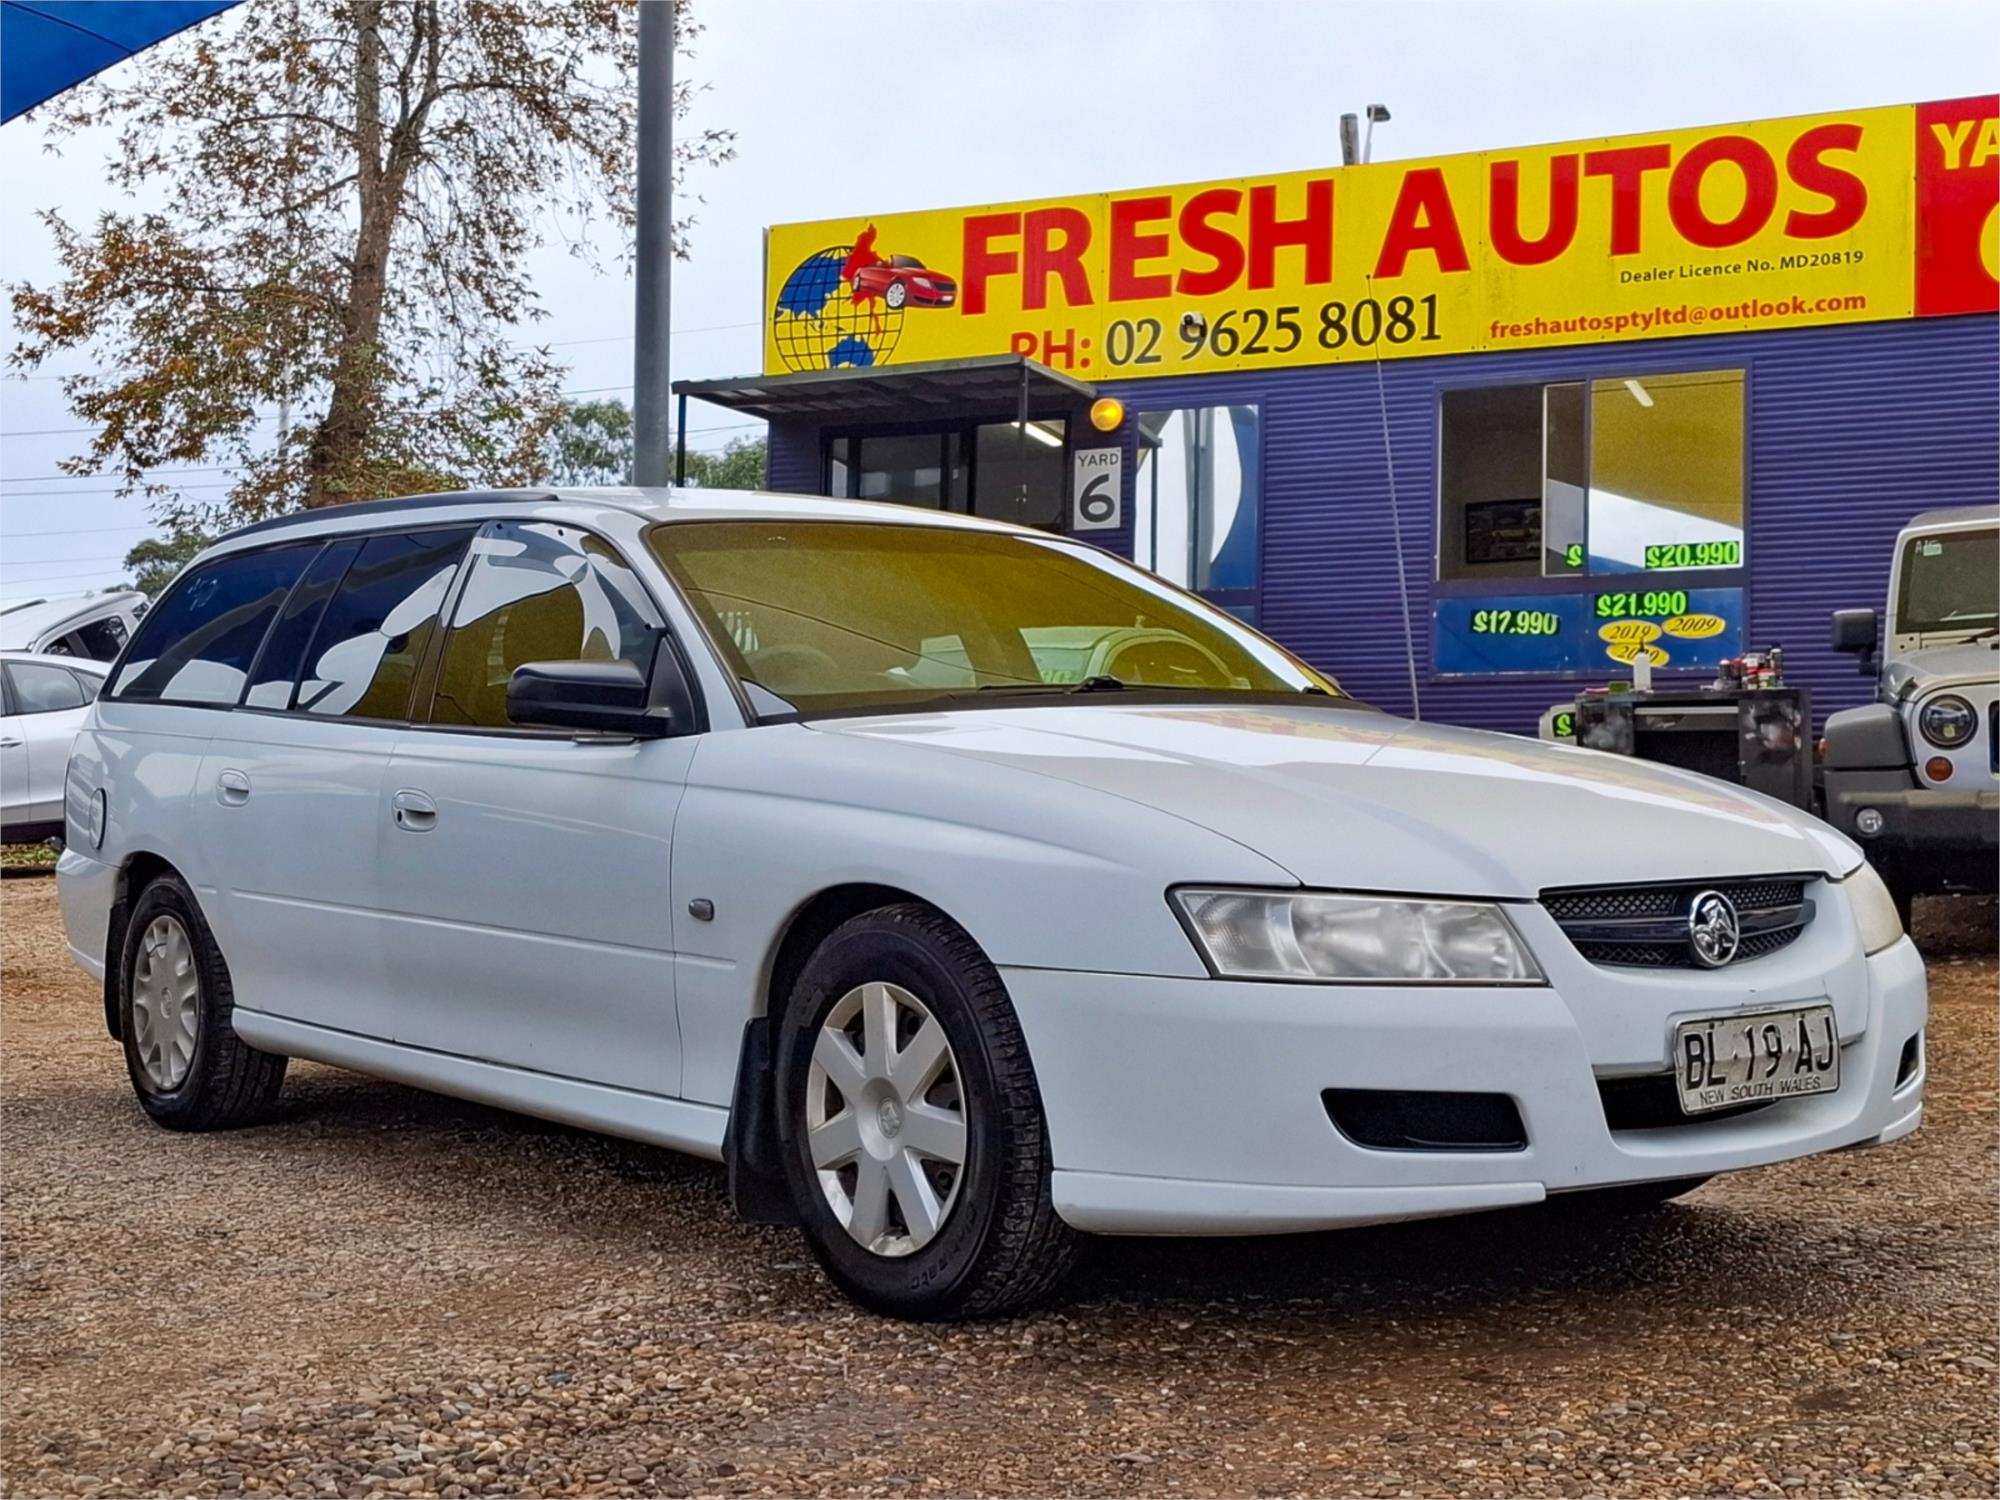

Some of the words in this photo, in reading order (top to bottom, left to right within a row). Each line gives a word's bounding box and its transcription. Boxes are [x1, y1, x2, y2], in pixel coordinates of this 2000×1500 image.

[961, 179, 1334, 316] FRESH
[1373, 123, 1868, 280] AUTOS
[1620, 267, 1675, 283] Dealer
[1679, 263, 1742, 279] Licence
[1747, 259, 1776, 272] No.
[1780, 250, 1864, 270] MD20819
[1011, 328, 1091, 369] PH:
[1106, 318, 1162, 366] 02
[1179, 306, 1302, 361] 9625
[1318, 293, 1442, 350] 8081
[1489, 294, 1867, 339] freshautosptyltd@outlook.com
[1078, 453, 1119, 467] YARD
[1080, 473, 1115, 523] 6
[1669, 617, 1718, 632] 2009
[1683, 1029, 1727, 1090] BL
[1744, 1023, 1783, 1081] 19
[1794, 1015, 1834, 1075] AJ
[1699, 1089, 1726, 1106] NEW
[1731, 1083, 1774, 1100] SOUTH
[1780, 1076, 1821, 1093] WALES
